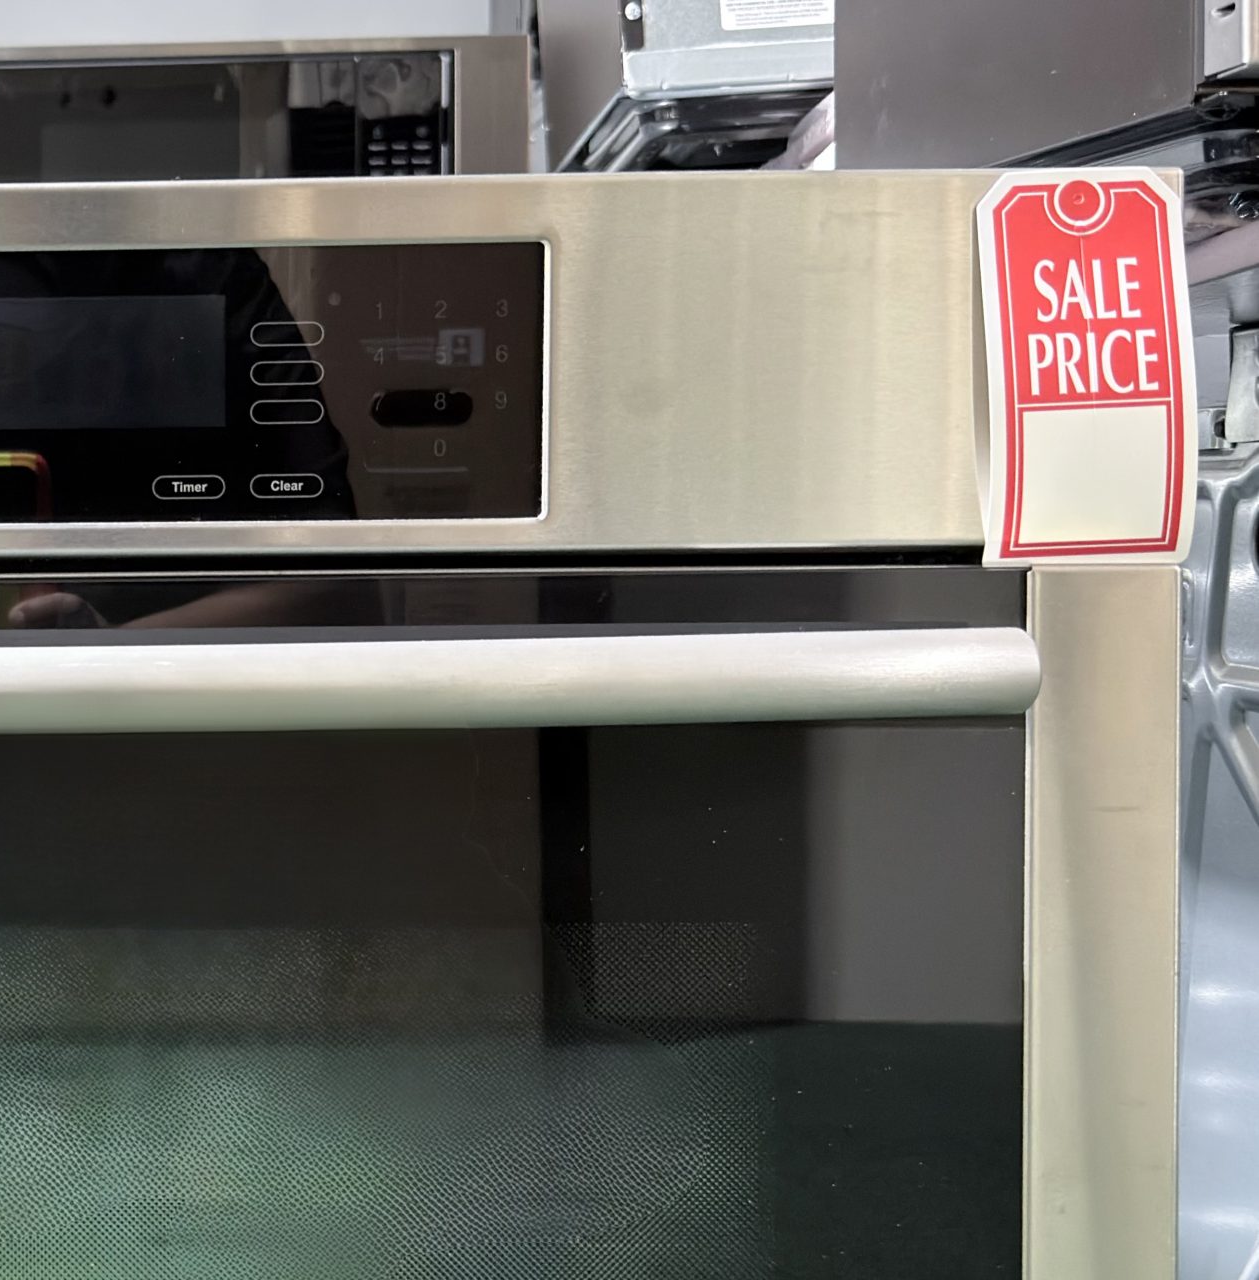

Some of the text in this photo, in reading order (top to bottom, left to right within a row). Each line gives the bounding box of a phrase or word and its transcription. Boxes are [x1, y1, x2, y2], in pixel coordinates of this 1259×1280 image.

[1033, 257, 1141, 323] SALE
[434, 301, 448, 319] 2
[495, 299, 509, 318] 3
[373, 347, 385, 365] 4
[495, 345, 509, 363] 6
[1027, 329, 1159, 396] PRICE
[433, 392, 447, 411] 8
[494, 391, 508, 410] 9
[171, 481, 208, 493] Timer
[270, 480, 304, 492] Clear
